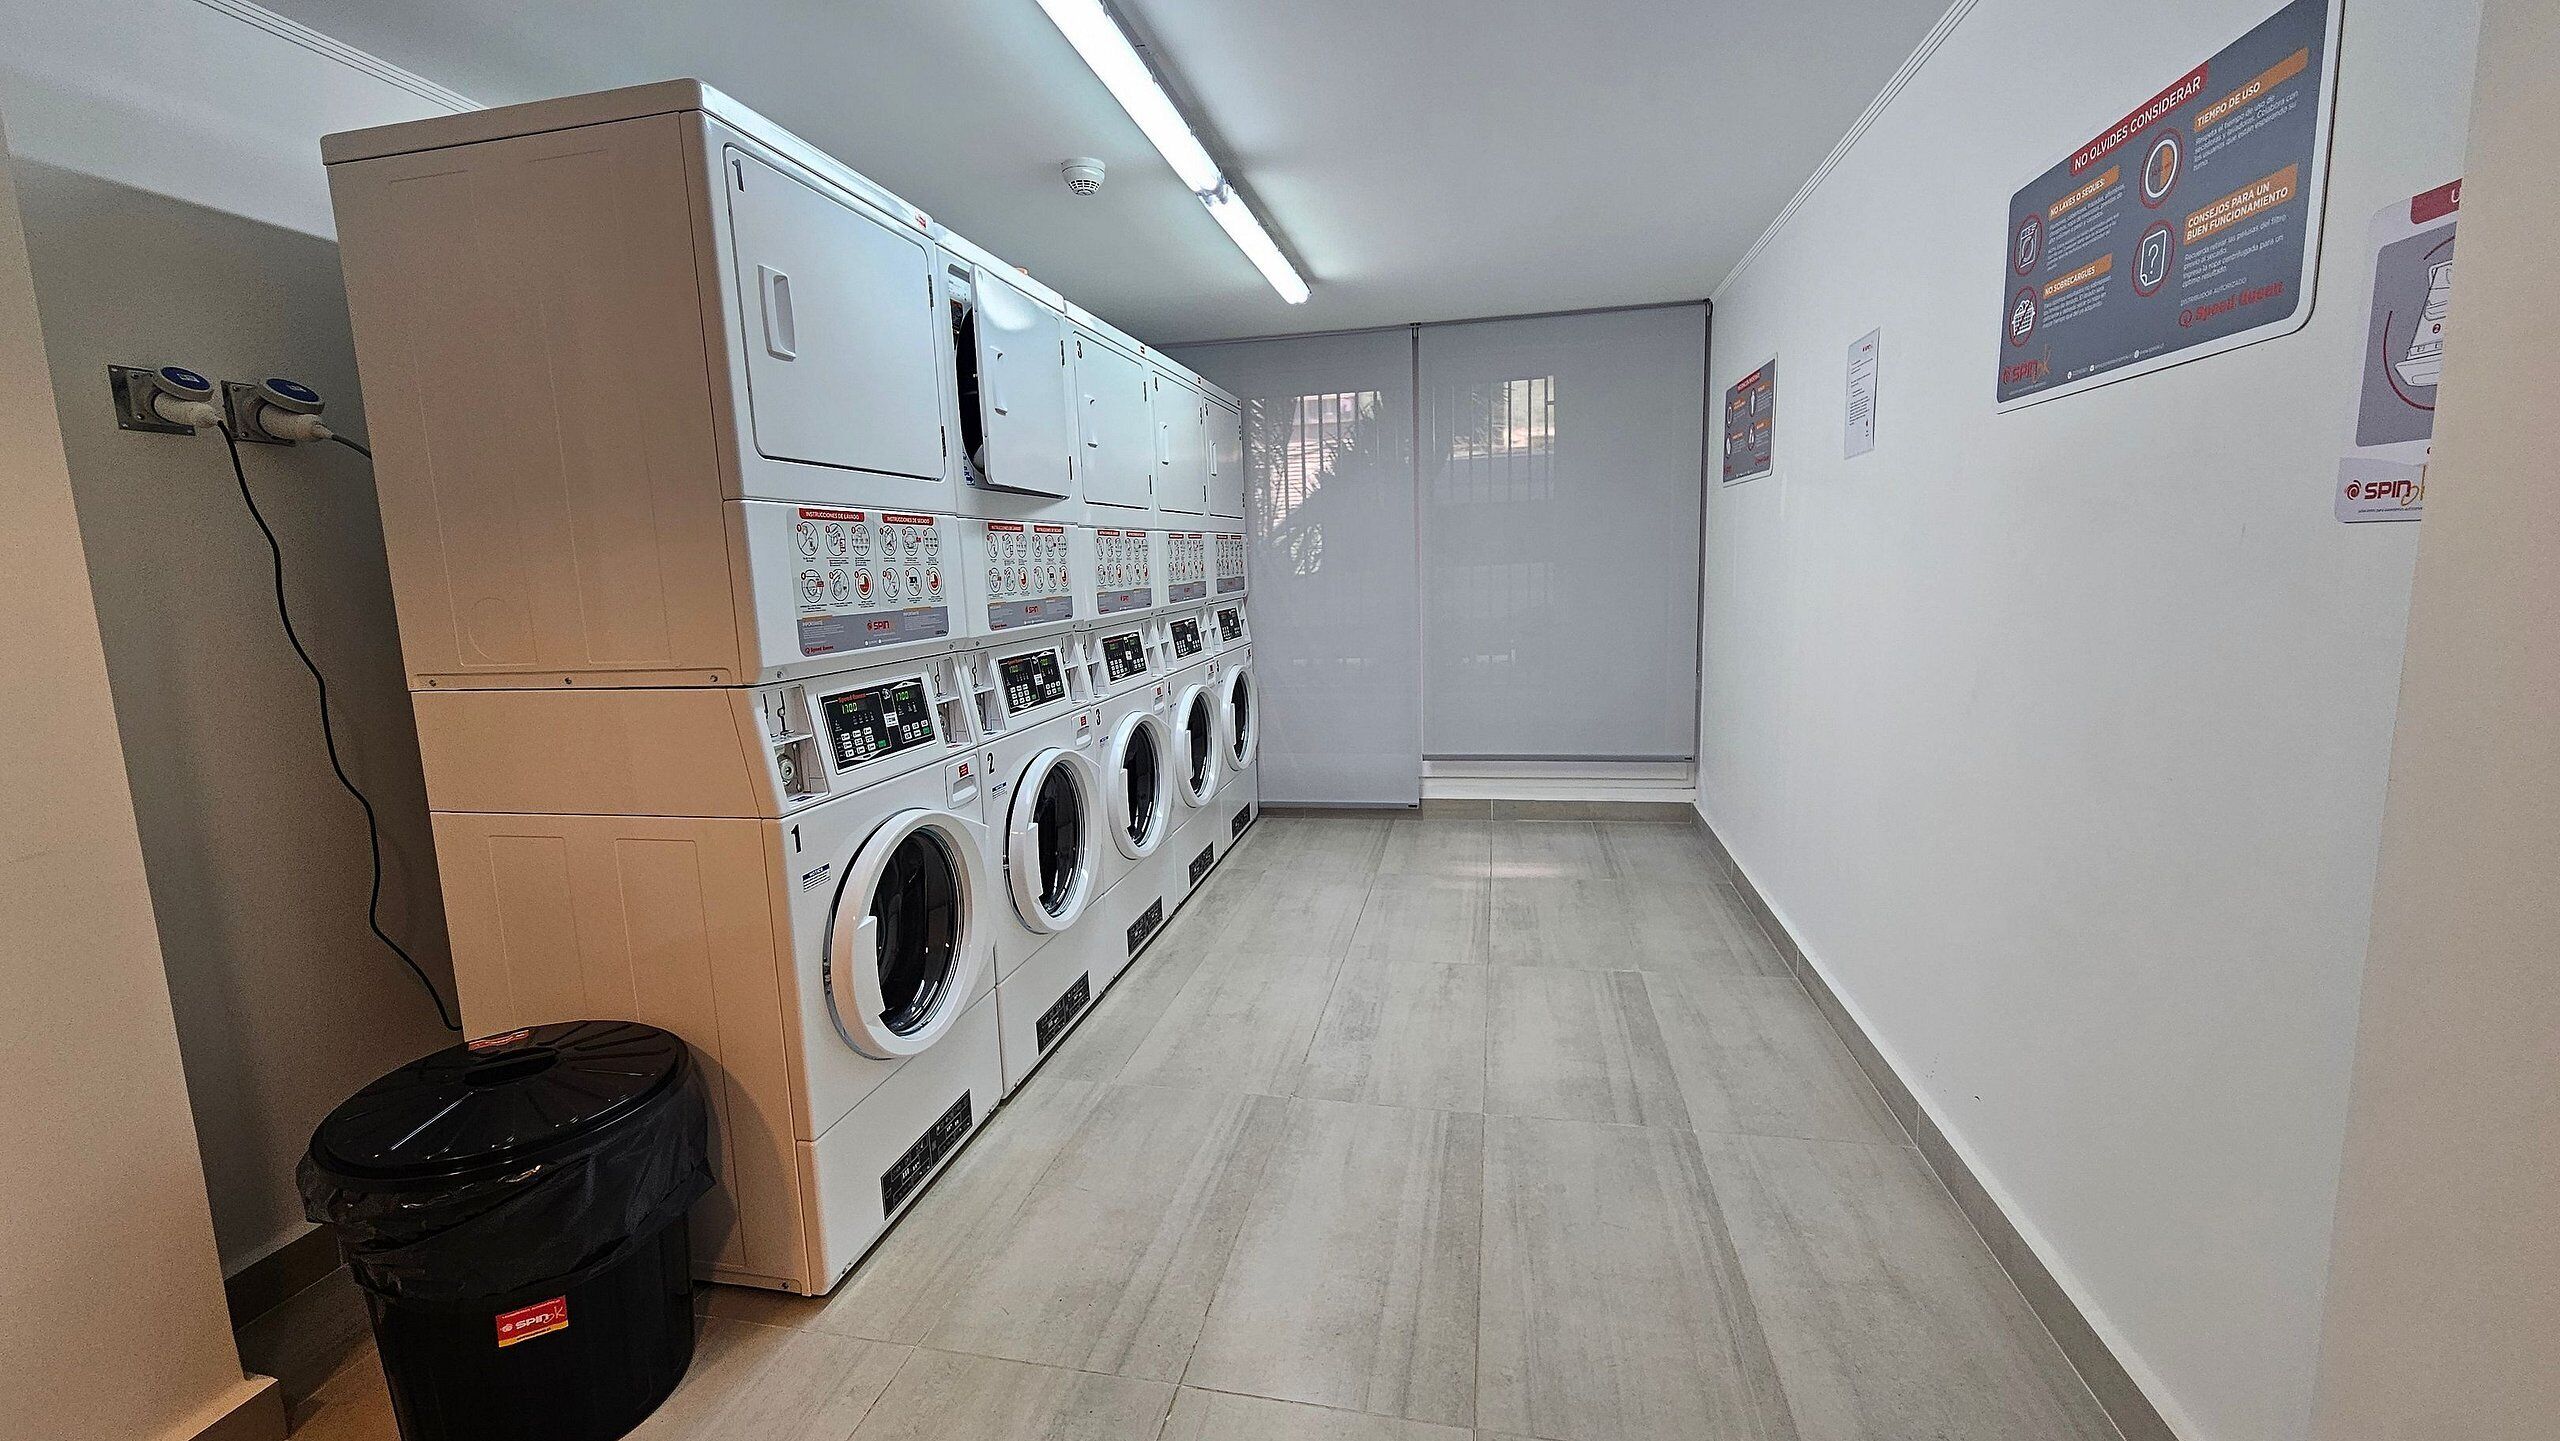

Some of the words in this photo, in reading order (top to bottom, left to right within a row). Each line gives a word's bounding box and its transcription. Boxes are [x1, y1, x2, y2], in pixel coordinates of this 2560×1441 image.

[2197, 102, 2227, 127] TIEMPO
[2228, 93, 2240, 109] DE
[2242, 82, 2260, 100] USO
[2074, 152, 2088, 170] NO
[2090, 125, 2128, 163] OLVIDES
[2130, 76, 2200, 133] CONSIDERAR
[732, 158, 744, 192] 1
[2050, 206, 2058, 218] NO
[2059, 195, 2076, 212] LAVES
[2076, 192, 2081, 200] O
[2186, 223, 2208, 241] BUEN
[2209, 186, 2288, 232] FUNCIONAMIENTO
[2188, 201, 2230, 228] CONSEJOS
[2231, 190, 2254, 208] PARA
[2256, 182, 2270, 195] UN
[2044, 286, 2054, 296] NO
[2054, 266, 2096, 292] SOBRECARGUES
[1077, 340, 1082, 359] 3
[1096, 708, 1101, 726] 3
[987, 752, 994, 774] 2
[791, 824, 802, 854] 1
